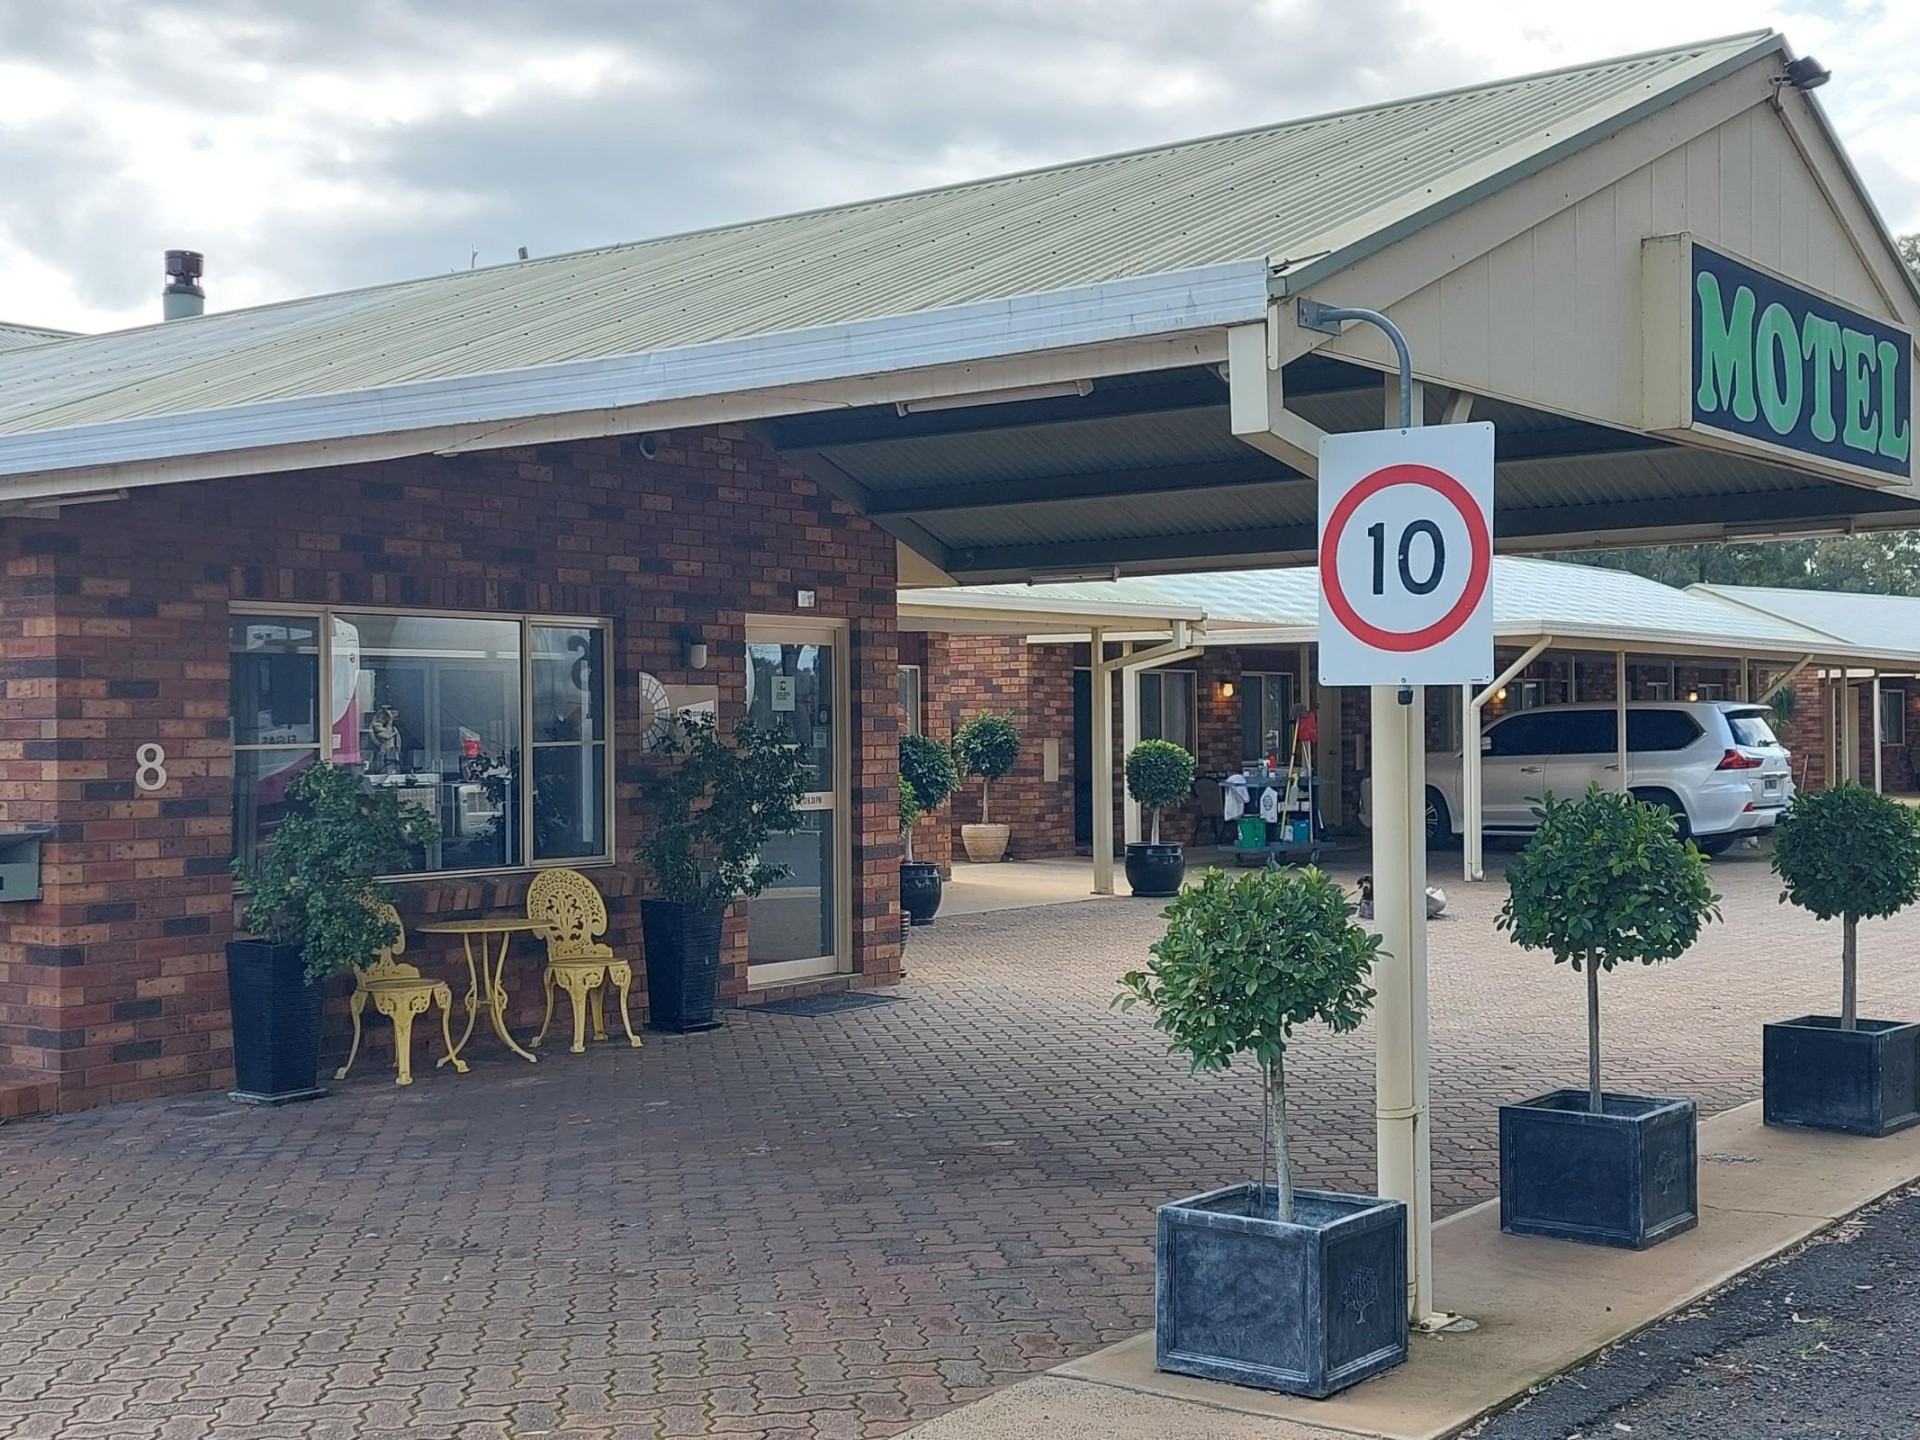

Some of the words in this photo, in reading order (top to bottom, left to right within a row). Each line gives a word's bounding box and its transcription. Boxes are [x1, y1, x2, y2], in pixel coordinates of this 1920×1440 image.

[1697, 271, 1909, 462] MOTEL
[1367, 519, 1446, 595] 10
[135, 743, 167, 791] 8
